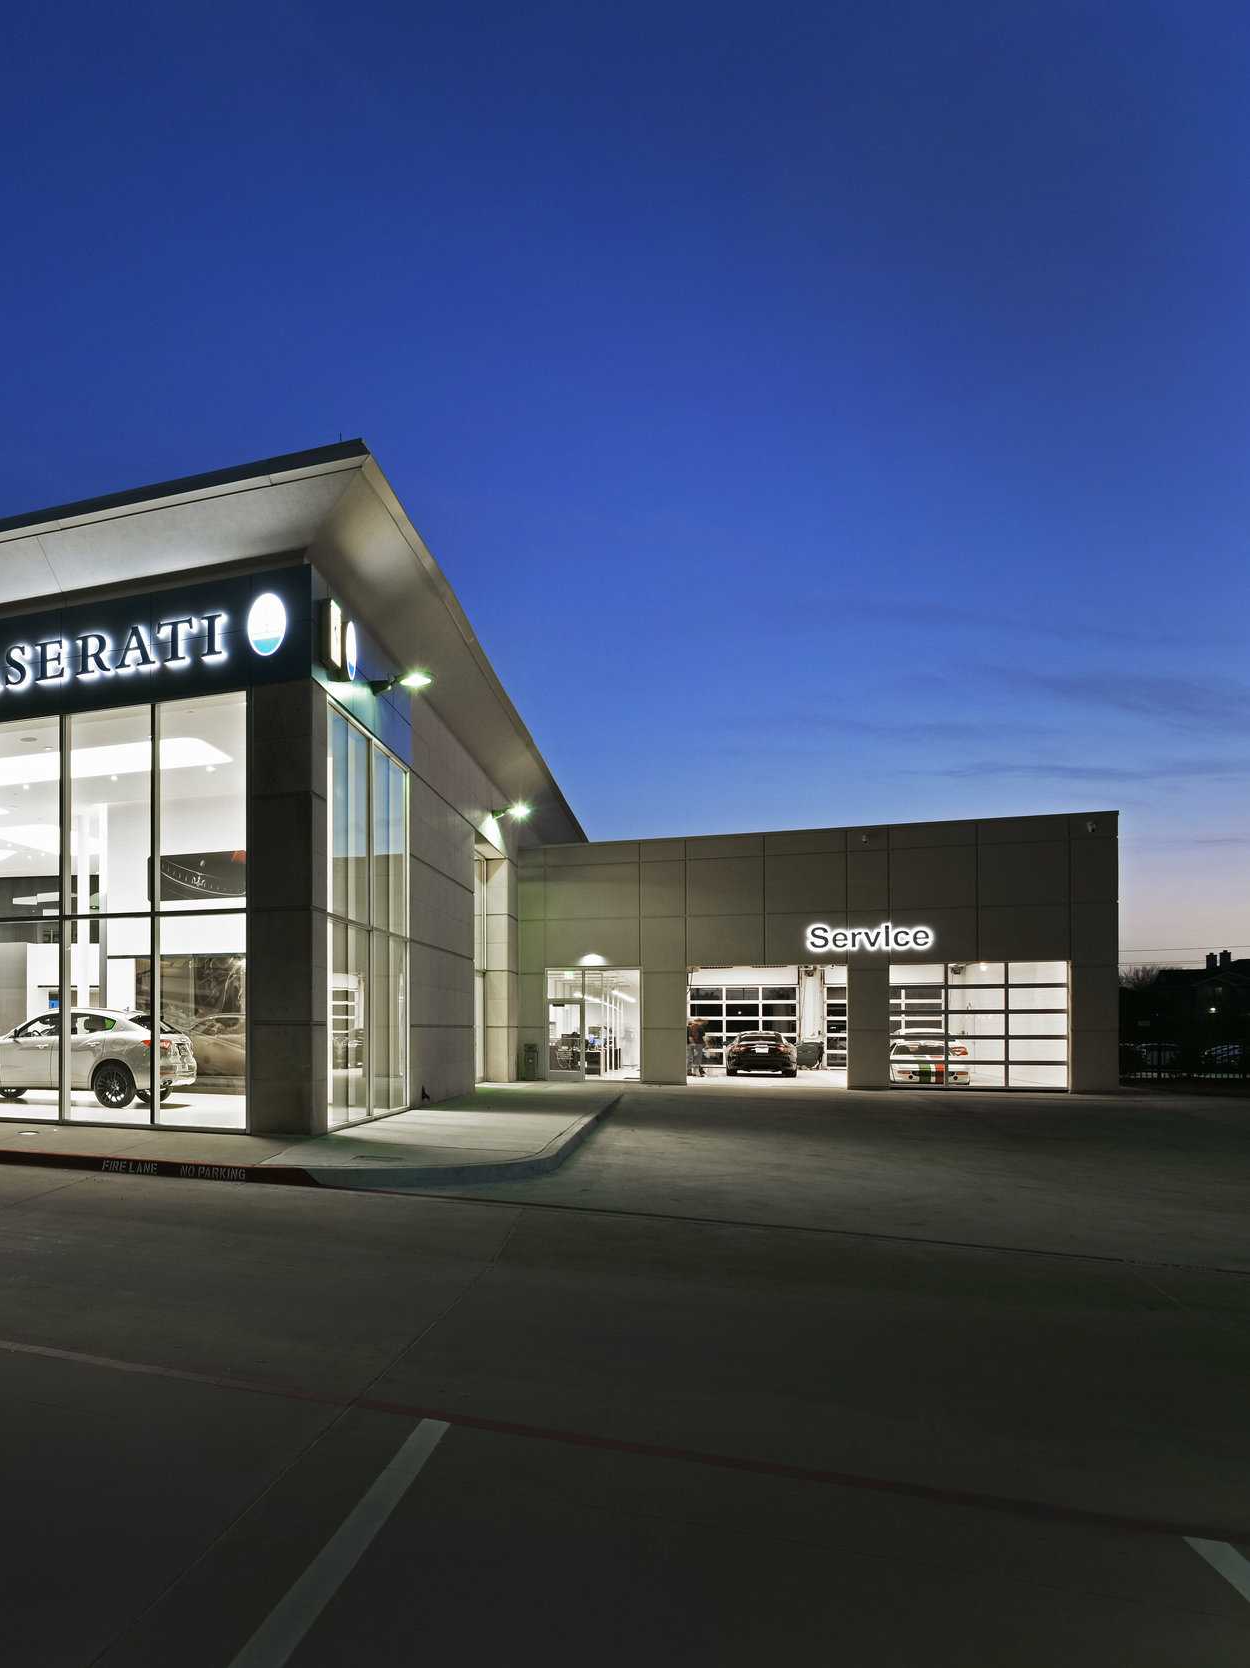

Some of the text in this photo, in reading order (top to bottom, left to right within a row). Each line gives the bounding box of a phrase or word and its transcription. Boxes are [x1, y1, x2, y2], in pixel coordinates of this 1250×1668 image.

[810, 925, 930, 949] Service
[101, 1159, 247, 1181] FIRE LANE NO PARKING
